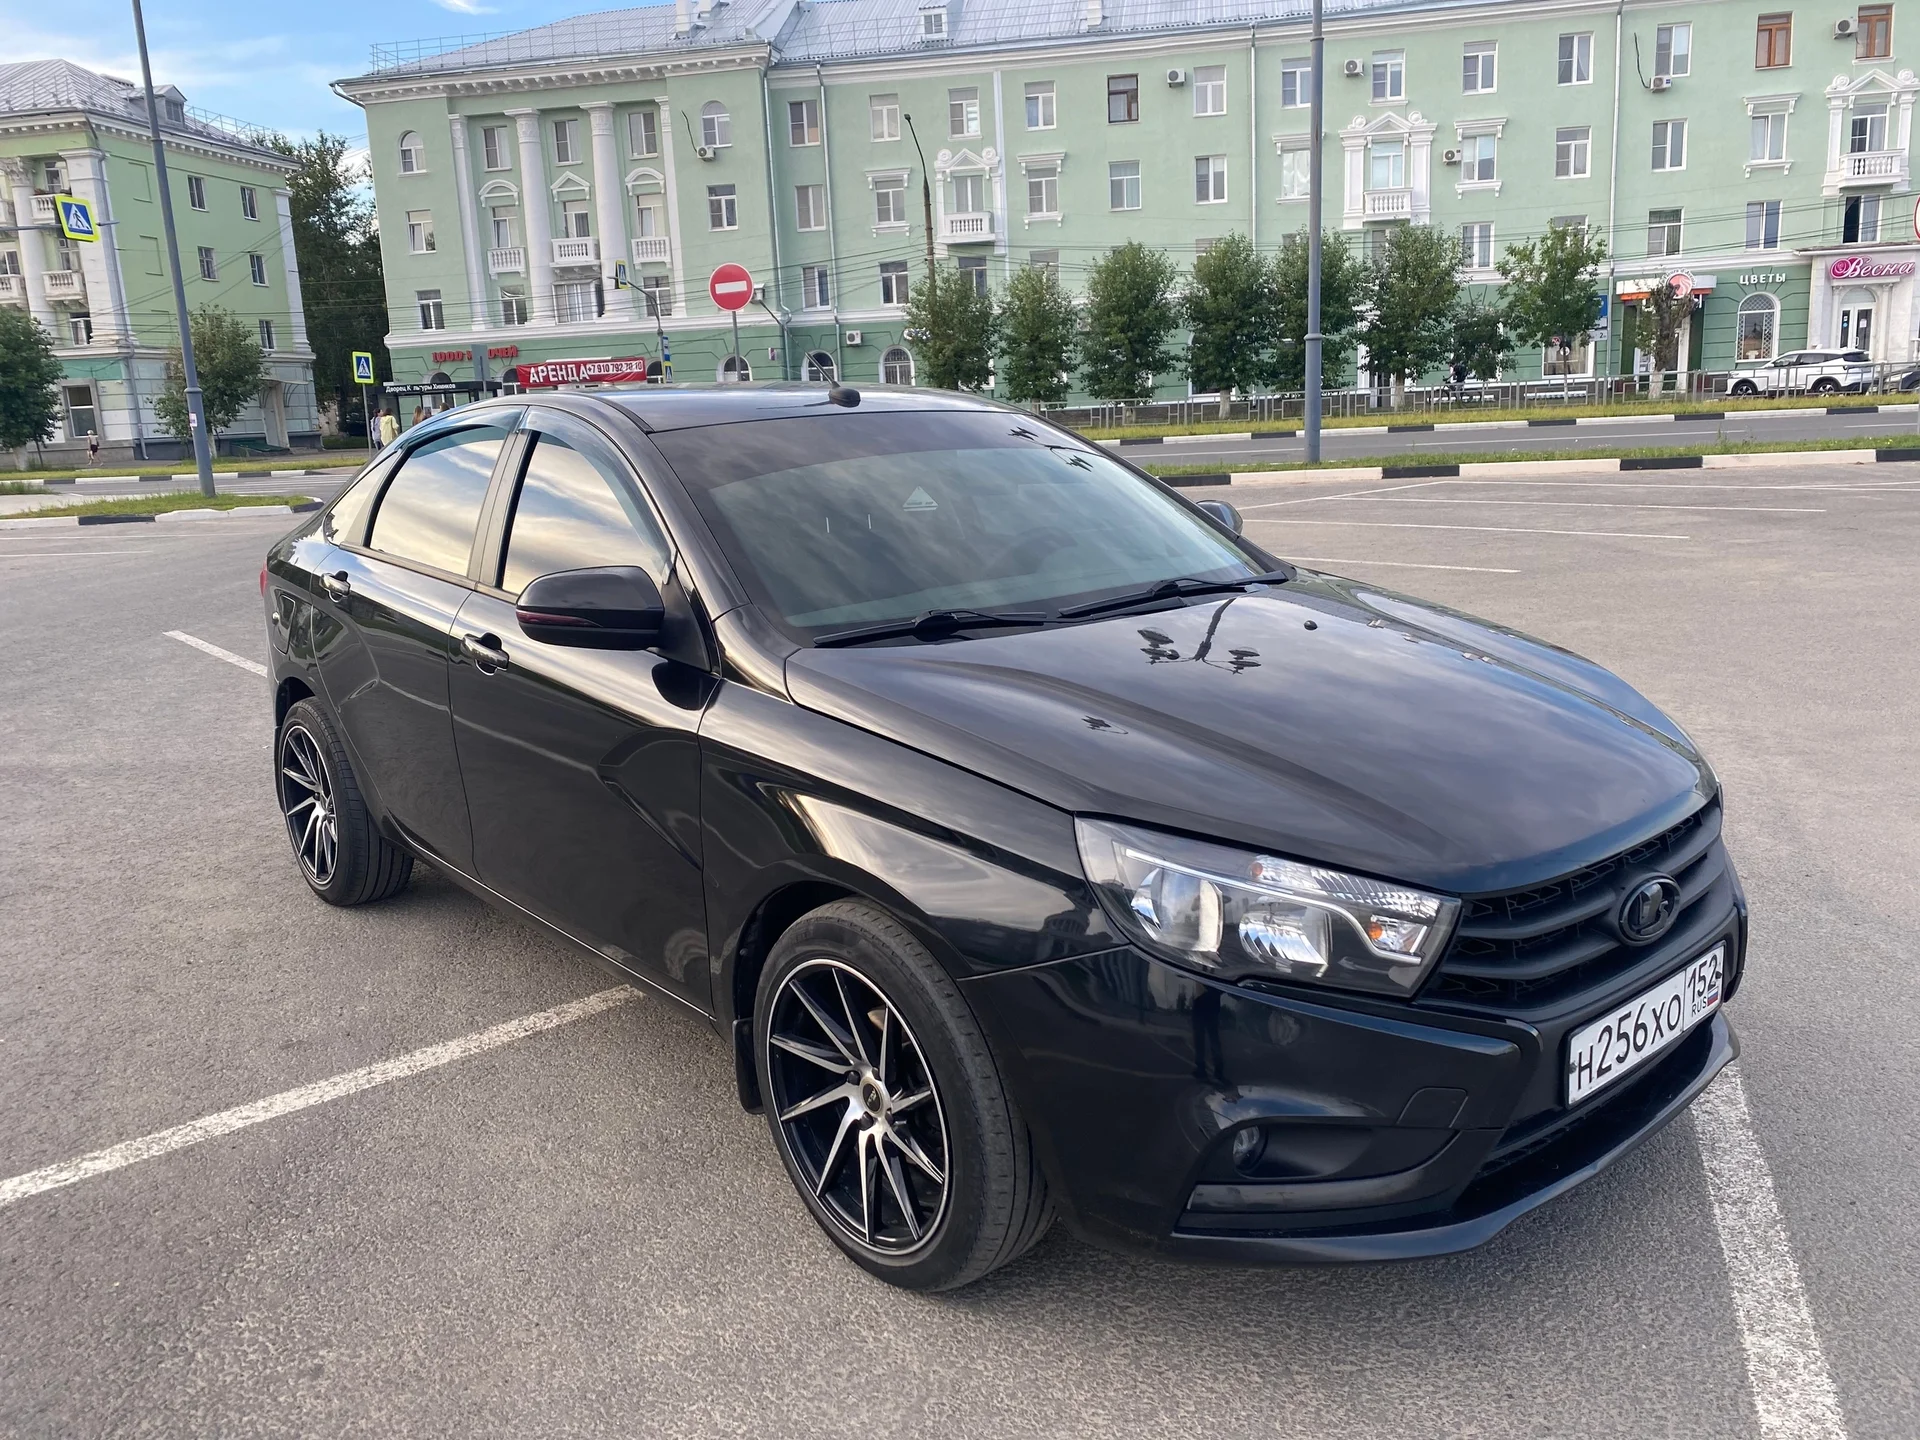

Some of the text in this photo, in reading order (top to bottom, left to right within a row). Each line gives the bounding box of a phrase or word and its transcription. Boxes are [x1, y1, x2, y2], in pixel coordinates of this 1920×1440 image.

[1838, 255, 1916, 278] Весна
[1739, 273, 1786, 286] ЦВЕТЫ
[529, 363, 590, 383] АРЕНДА
[597, 363, 610, 373] 910
[610, 363, 624, 372] 792
[385, 385, 406, 393] Дворец
[406, 384, 433, 392] Кльтуры
[1691, 996, 1707, 1018] RUS
[1577, 954, 1719, 1091] Н256ХО 152
